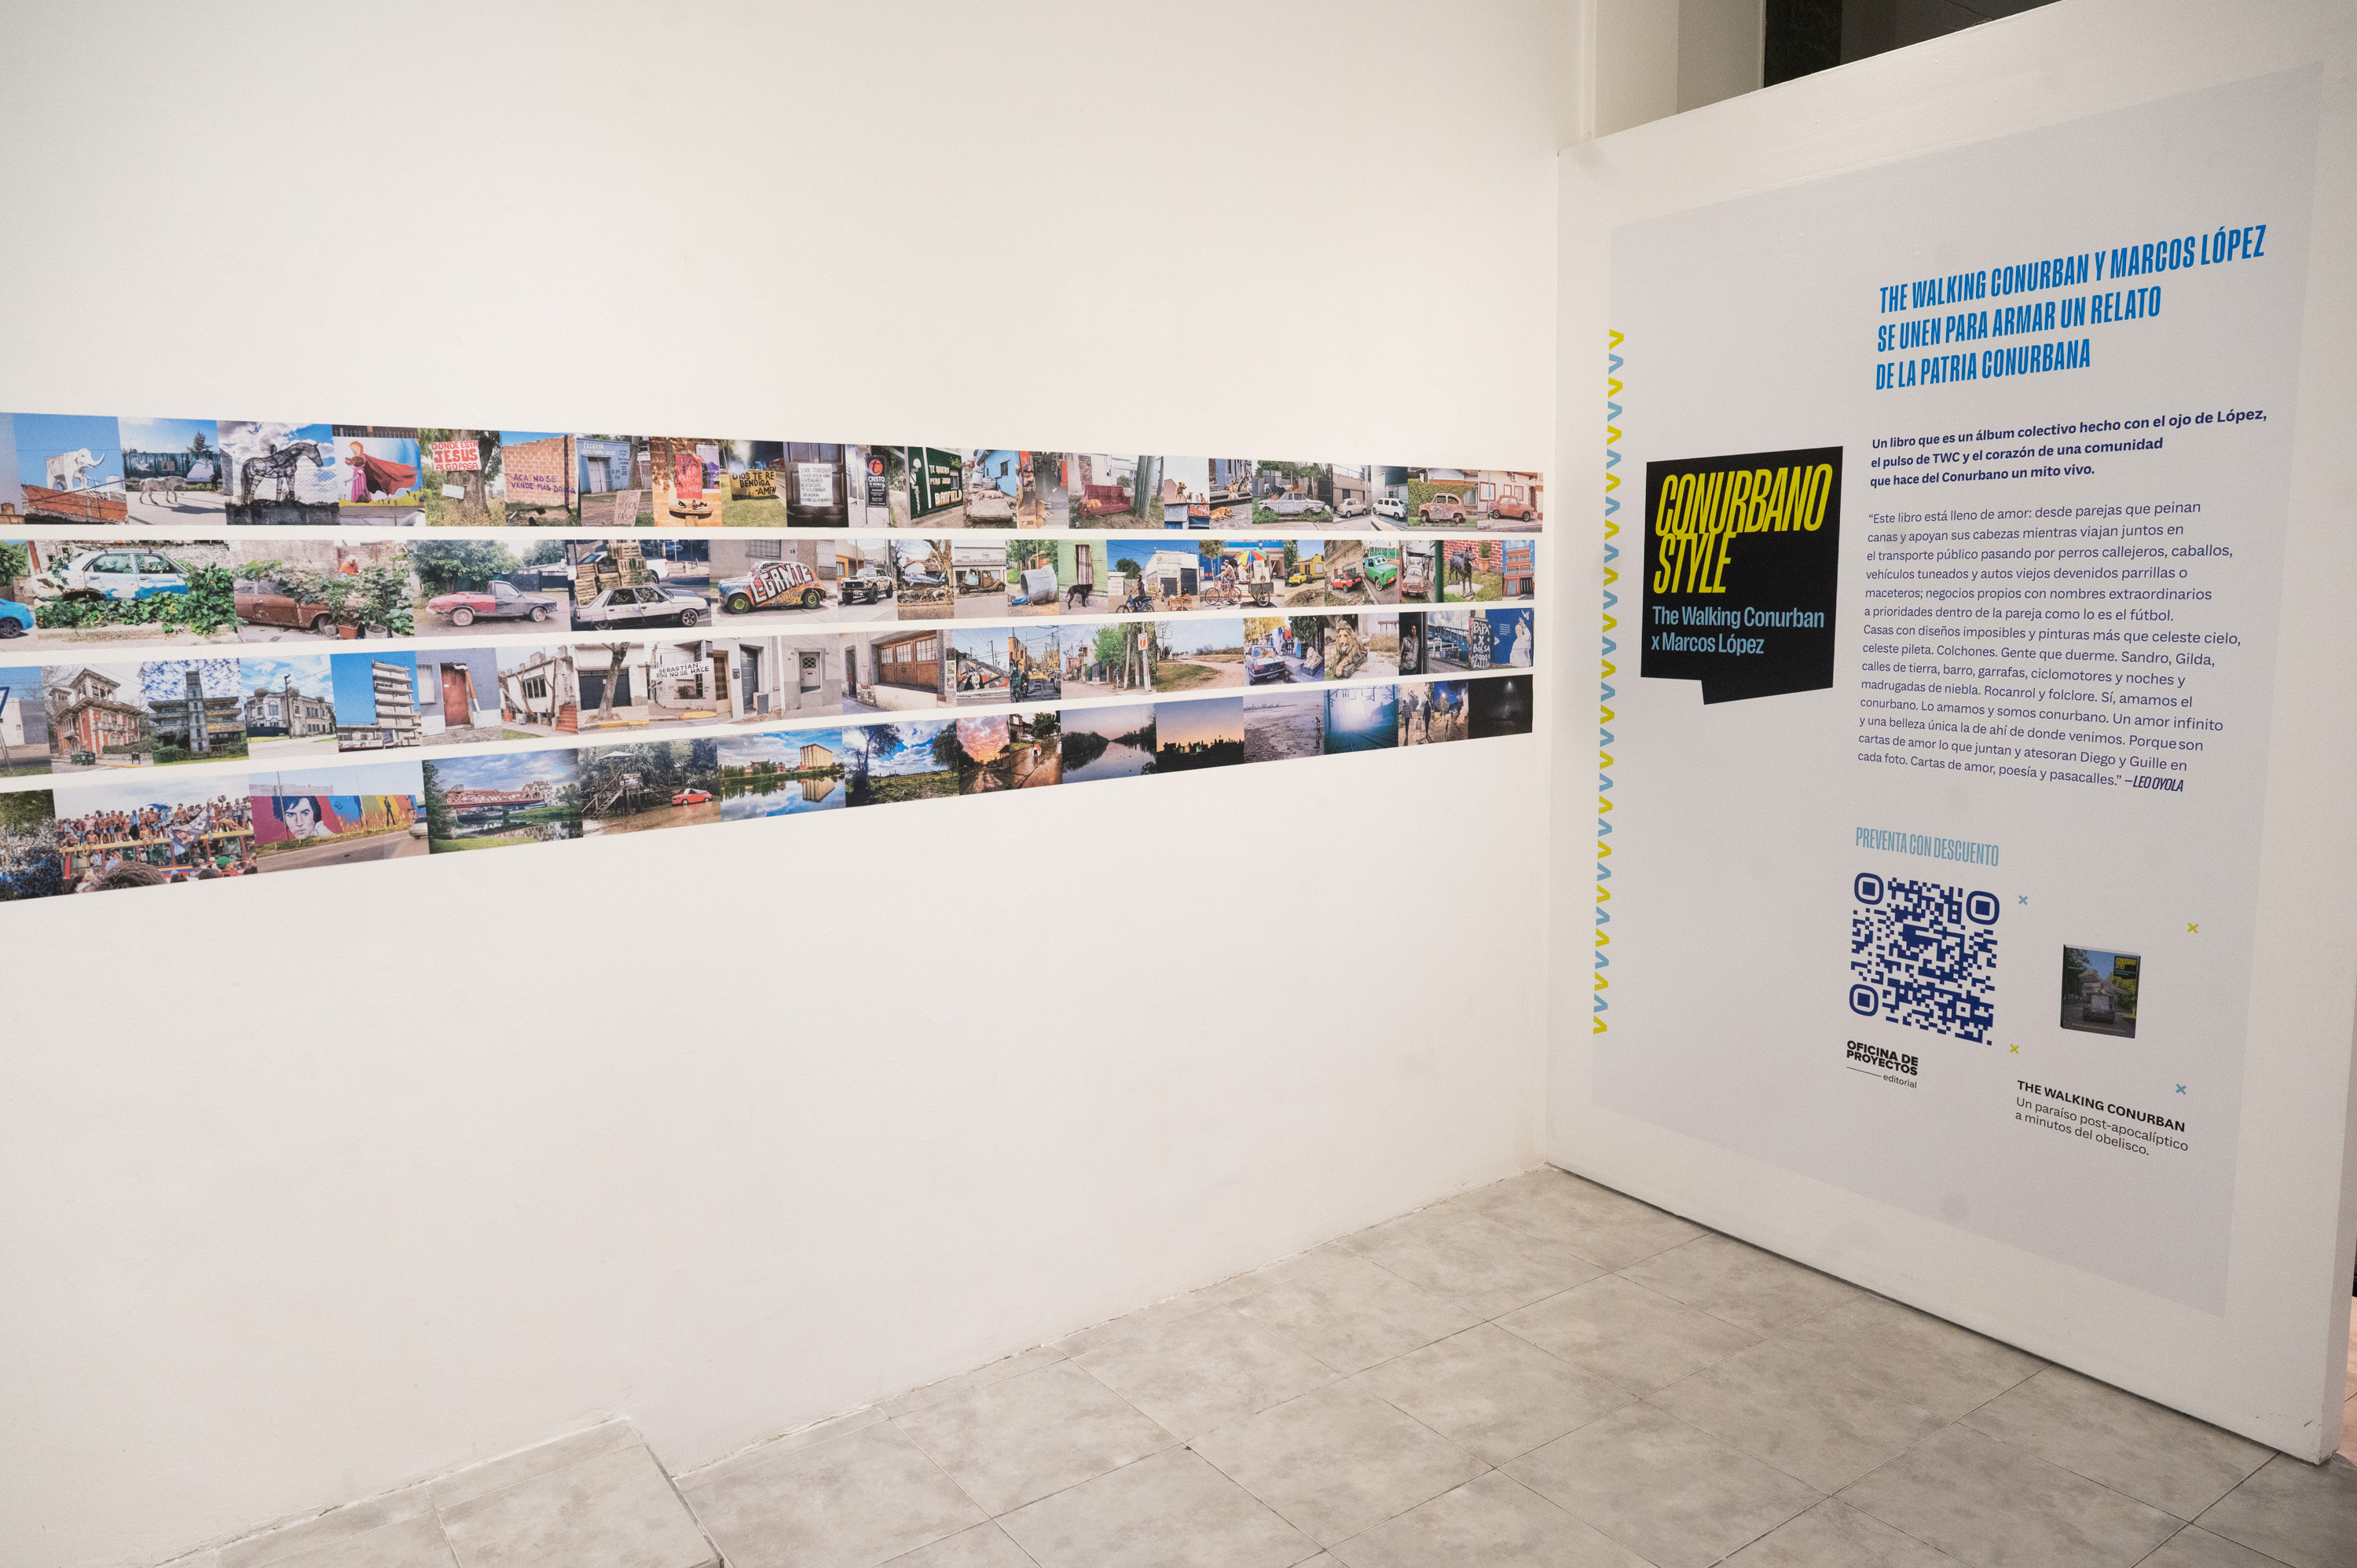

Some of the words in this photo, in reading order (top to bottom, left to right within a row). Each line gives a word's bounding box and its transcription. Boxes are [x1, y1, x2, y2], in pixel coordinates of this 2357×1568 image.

[1879, 284, 1908, 313] THE
[1912, 270, 1986, 309] WALKING
[1991, 253, 2089, 297] CONURBAN
[2095, 251, 2106, 281] Y
[2110, 236, 2195, 279] MARCOS
[2201, 224, 2267, 266] LÓPEZ
[1878, 324, 1896, 353] SE
[1899, 317, 1941, 350] UNEN
[1945, 311, 1988, 343] PARA
[1992, 302, 2056, 337] ARMAR
[2060, 296, 2086, 328] UN
[2091, 285, 2161, 324] RELATO
[1875, 362, 1895, 390] DE
[1898, 360, 1916, 388] LA
[1920, 352, 1977, 386] PATRIA
[1981, 339, 2090, 379] CONURBANA
[1872, 438, 1887, 449] Un
[1890, 437, 1915, 448] libro
[1918, 436, 1940, 448] que
[1942, 434, 1956, 444] es
[1958, 434, 1973, 442] un
[1976, 429, 2014, 441] álbum
[2018, 423, 2077, 438] colectivo
[2080, 419, 2121, 433] hecho
[2124, 419, 2150, 430] con
[2153, 415, 2165, 427] el
[2168, 413, 2191, 429] ojo
[2194, 412, 2213, 424] de
[2217, 408, 2267, 424] López,
[431, 441, 459, 450] DONDE
[434, 449, 478, 463] JESUS
[1871, 457, 1881, 467] el
[1882, 456, 1914, 470] pulso
[1916, 454, 1930, 465] de
[1932, 452, 1960, 463] TWC
[1963, 453, 1970, 464] y
[1972, 449, 1983, 461] el
[1985, 446, 2035, 460] corazón
[2038, 445, 2054, 456] de
[2057, 445, 2082, 456] una
[2084, 437, 2163, 453] comunidad
[435, 463, 458, 471] ALGO
[458, 462, 478, 471] PASA
[765, 471, 775, 480] RE
[929, 464, 936, 474] TE
[1870, 478, 1891, 489] que
[1893, 474, 1919, 485] hace
[1922, 472, 1939, 484] del
[1942, 470, 2009, 482] Conurbano
[2011, 470, 2027, 478] un
[2030, 466, 2061, 478] mito
[2063, 463, 2095, 475] vivo.
[1655, 463, 1833, 537] CONURBANO
[1898, 512, 1922, 522] libro
[1924, 510, 1948, 522] está
[1951, 510, 1978, 521] lleno
[1980, 509, 1995, 520] de
[1997, 510, 2032, 519] amor:
[2035, 506, 2073, 518] desde
[2076, 504, 2122, 519] parejas
[2125, 505, 2150, 518] que
[2154, 501, 2201, 517] peinan
[1653, 531, 1737, 594] STYLE
[1865, 588, 1923, 599] maceteros;
[1926, 588, 1974, 601] negocios
[1978, 588, 2022, 601] propios
[2025, 590, 2046, 599] con
[2050, 588, 2106, 599] nombres
[2109, 588, 2212, 600] extraordinarios
[1473, 621, 1490, 636] PAPA
[1652, 606, 1679, 625] The
[1682, 606, 1741, 629] Walking
[1744, 606, 1824, 628] Conurban
[1478, 635, 1484, 646] X
[1651, 636, 1659, 650] x
[1662, 632, 1716, 652] Marcos
[1718, 633, 1765, 656] López
[1863, 643, 1899, 654] celeste
[1901, 643, 1934, 656] pileta.
[1937, 645, 1998, 657] Colchones.
[2001, 647, 2036, 658] Gente
[2039, 650, 2062, 661] que
[2066, 649, 2117, 661] duerme.
[2121, 651, 2172, 666] Sandro,
[2176, 653, 2215, 668] Gilda,
[1858, 752, 1882, 763] cada
[1885, 753, 1908, 765] foto.
[1911, 756, 1945, 768] Cartas
[1948, 760, 1962, 770] de
[1964, 763, 1996, 775] amor,
[1999, 766, 2037, 778] poesía
[2040, 770, 2047, 781] y
[2152, 777, 2184, 792] OYOLA
[1856, 827, 1907, 853] PREVENTA
[1910, 834, 1931, 857] CON
[1934, 837, 1999, 866] DESCUENTO
[1846, 1050, 1918, 1075] PROYECTOS
[1847, 1040, 1898, 1061] OFICINA
[1901, 1053, 1919, 1067] DE
[1883, 1075, 1917, 1089] editorial
[2017, 1080, 2042, 1095] THE
[2044, 1086, 2104, 1112] WALKING
[2107, 1104, 2185, 1133] CONURBAN
[2017, 1097, 2032, 1109] Un
[2035, 1104, 2077, 1121] paraíso
[2080, 1116, 2188, 1151] post-apocalíptico
[2025, 1115, 2072, 1134] minutos
[2075, 1127, 2092, 1140] del
[2095, 1134, 2149, 1156] obelisco.
